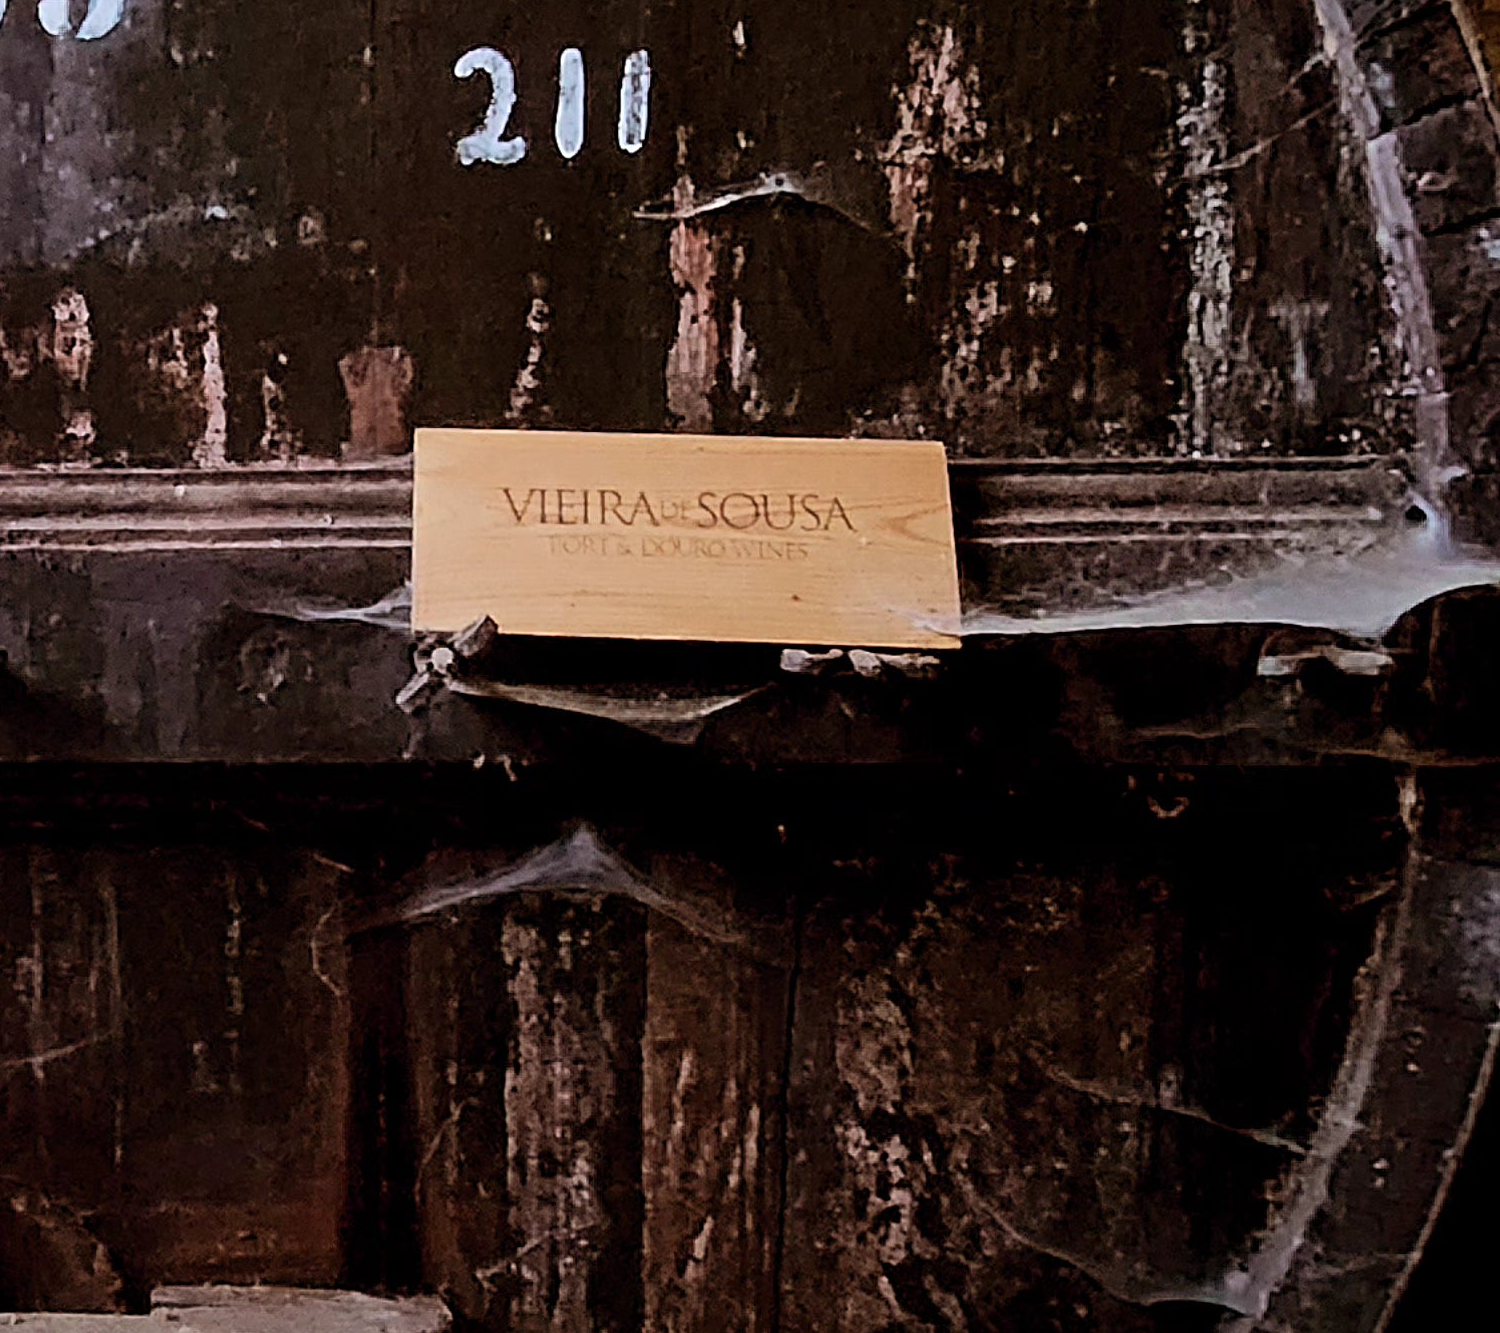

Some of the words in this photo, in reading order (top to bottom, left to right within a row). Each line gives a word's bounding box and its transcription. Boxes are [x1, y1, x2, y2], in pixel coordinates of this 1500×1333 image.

[454, 47, 651, 166] 211
[502, 487, 661, 527] VIEIRA
[697, 491, 858, 533] SOUSA
